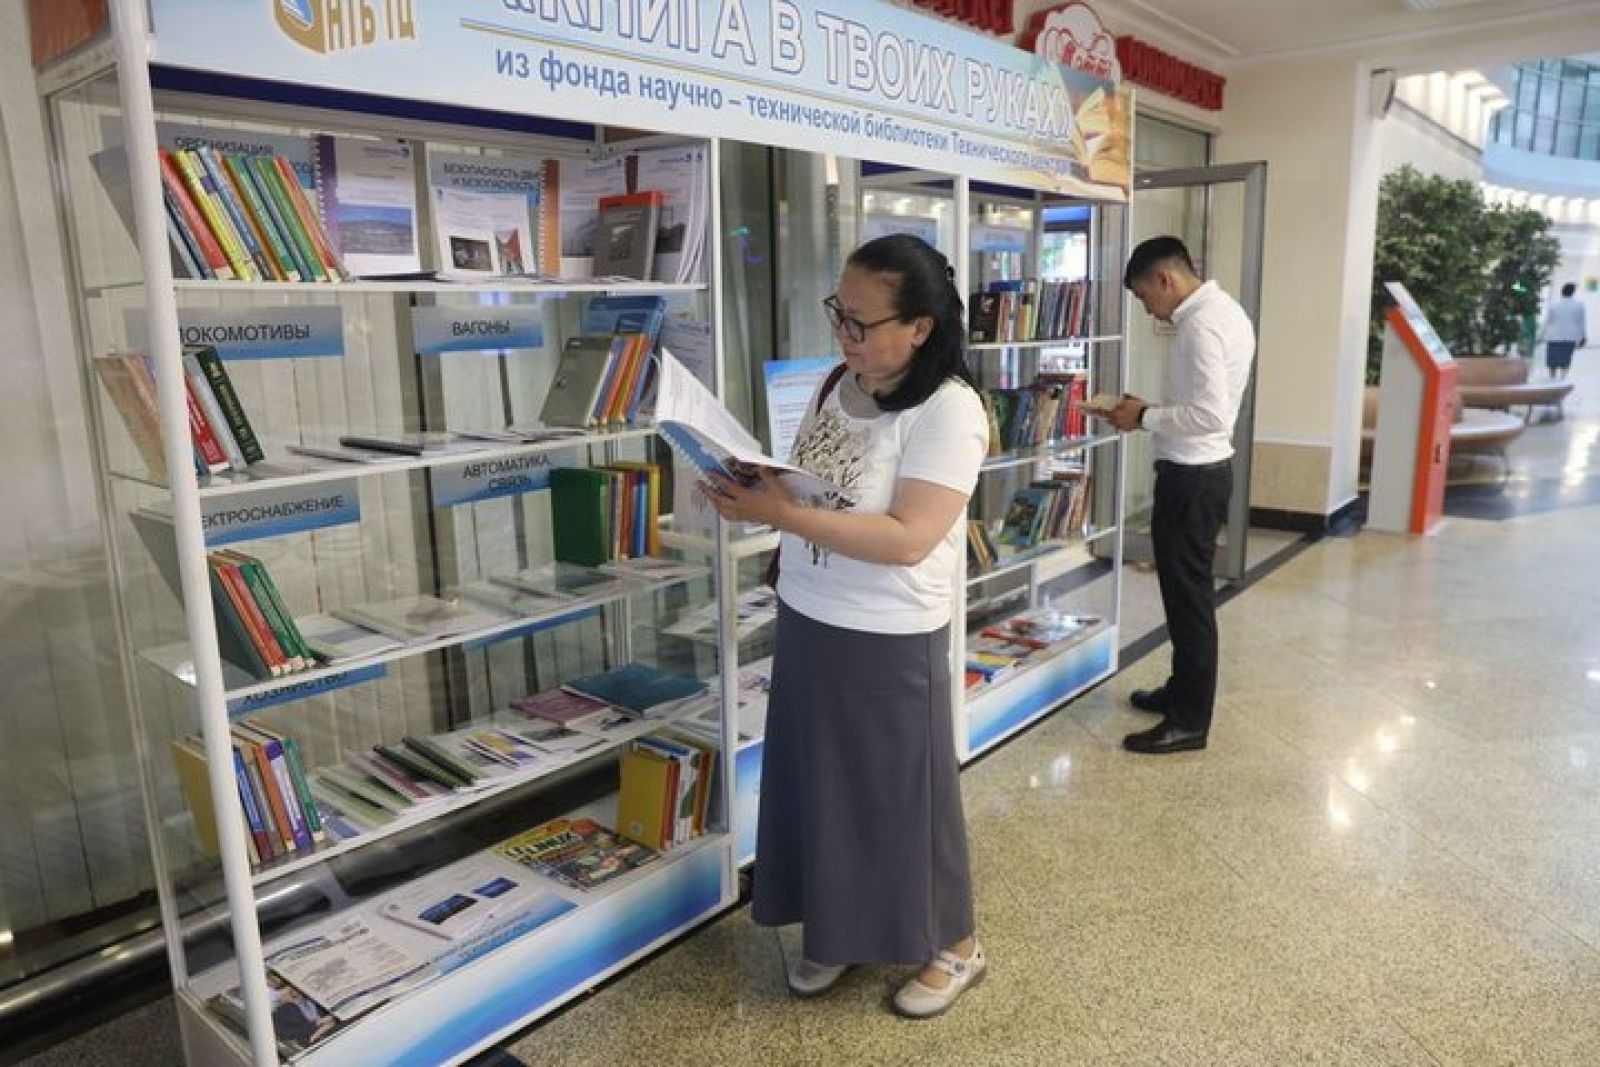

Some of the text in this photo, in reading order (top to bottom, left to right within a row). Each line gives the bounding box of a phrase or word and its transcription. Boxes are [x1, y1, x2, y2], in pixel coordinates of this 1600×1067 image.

[770, 0, 804, 74] В
[815, 9, 958, 113] ТВОИХ
[496, 48, 530, 78] из
[539, 49, 631, 98] фонда
[639, 74, 724, 110] научно
[746, 95, 861, 135] технической
[864, 112, 948, 152] библиотеки
[452, 320, 510, 336] ВАГОНЫ
[201, 494, 344, 530] ЕКТРОСНАБЖЕНИЕ
